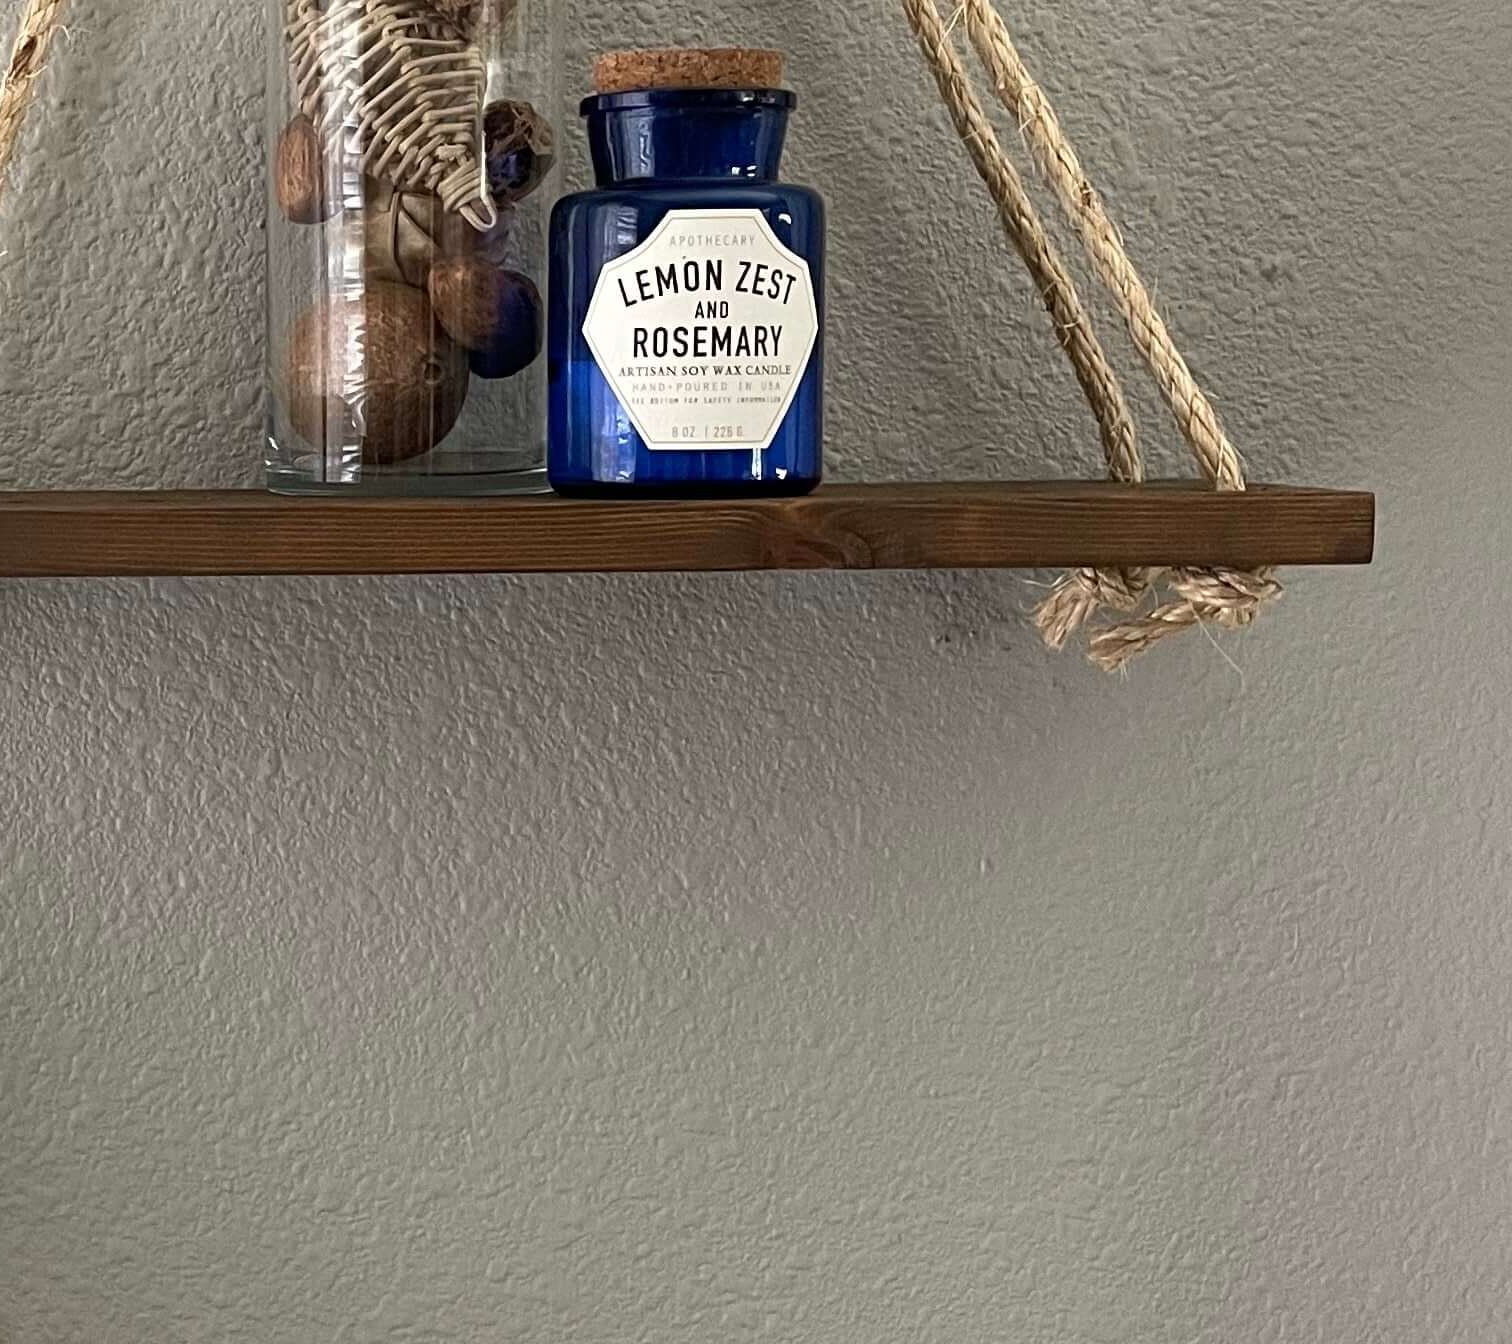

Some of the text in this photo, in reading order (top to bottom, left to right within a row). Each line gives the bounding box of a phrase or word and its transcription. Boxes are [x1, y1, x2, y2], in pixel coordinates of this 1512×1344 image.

[669, 235, 755, 247] APOTHECARY
[618, 260, 796, 306] LEMON ZEST
[695, 301, 729, 319] AND
[633, 325, 783, 357] ROSEMARY
[618, 365, 791, 377] ARTISAN SOY WAX CANDLE
[738, 381, 751, 392] IN
[760, 381, 780, 392] USA
[682, 426, 695, 437] OZ
